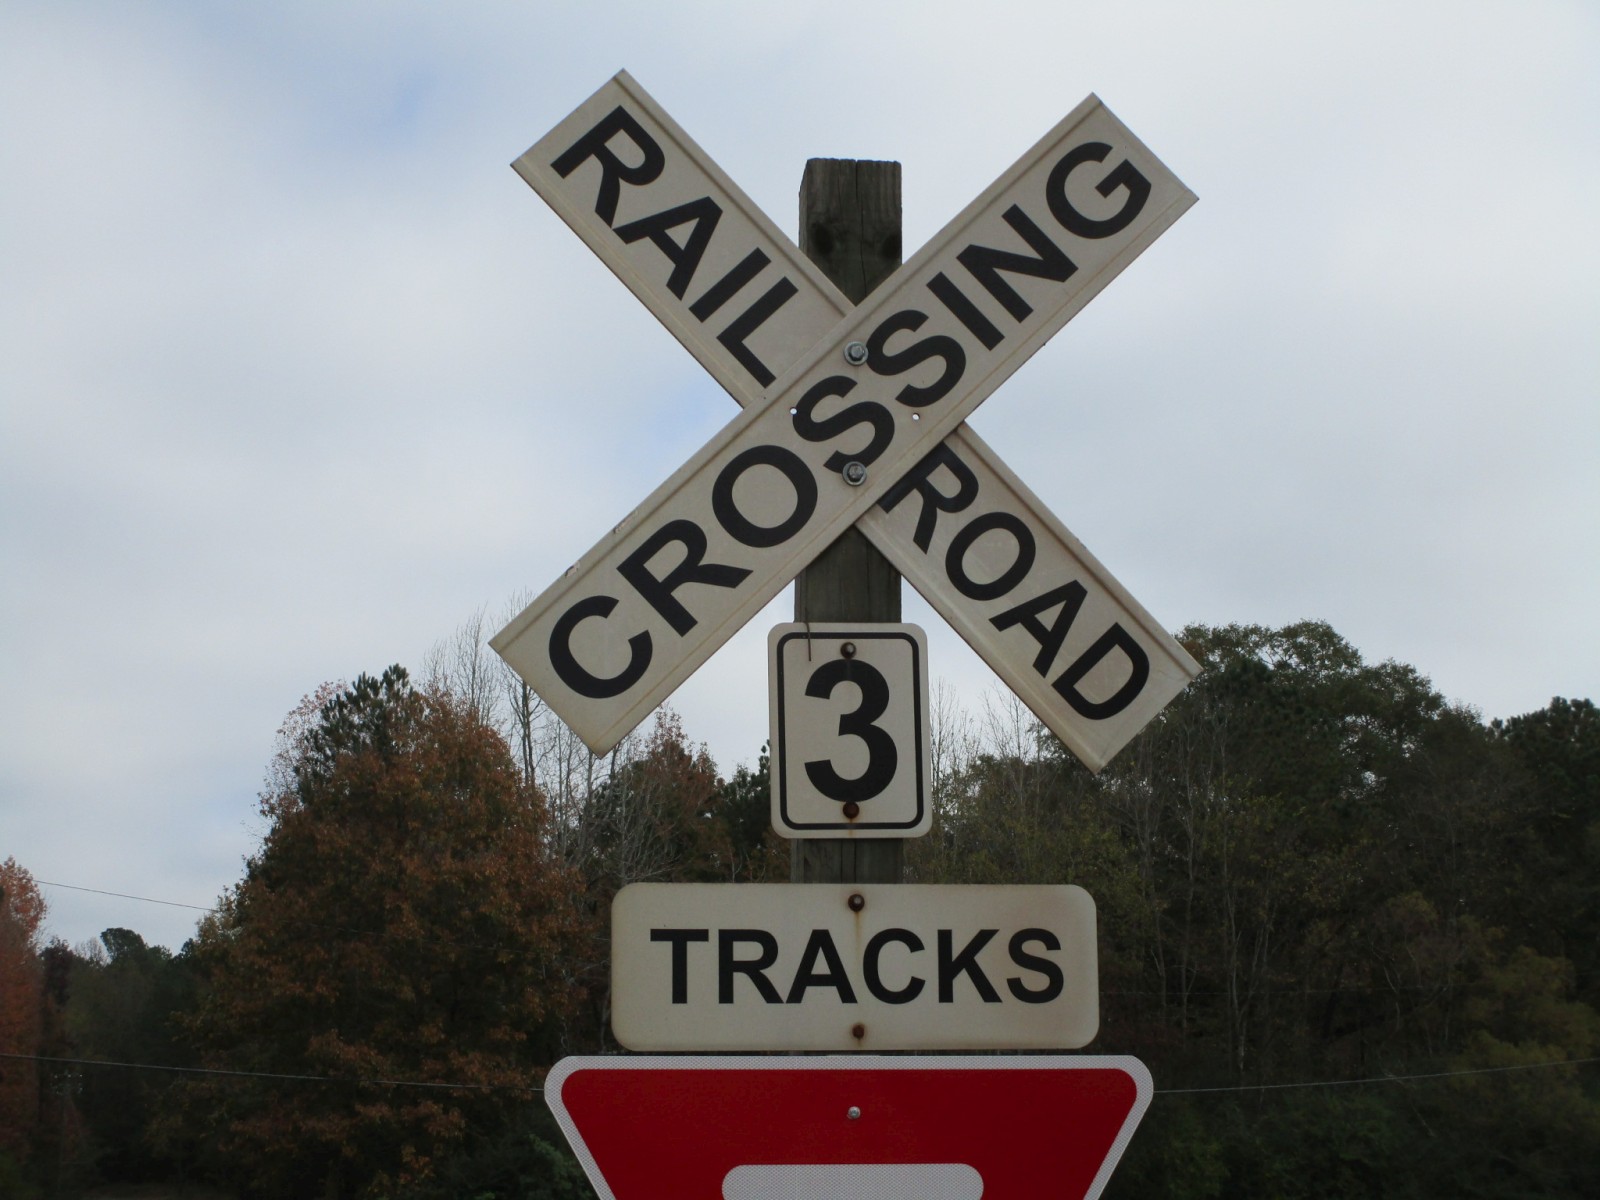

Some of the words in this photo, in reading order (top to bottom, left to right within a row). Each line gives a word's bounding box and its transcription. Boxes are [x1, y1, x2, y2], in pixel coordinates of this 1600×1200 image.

[548, 141, 1152, 699] CROSSING
[550, 105, 798, 388] RAIL
[876, 441, 1150, 720] ROAD
[804, 659, 898, 802] 3
[650, 927, 1065, 1005] TRACKS
